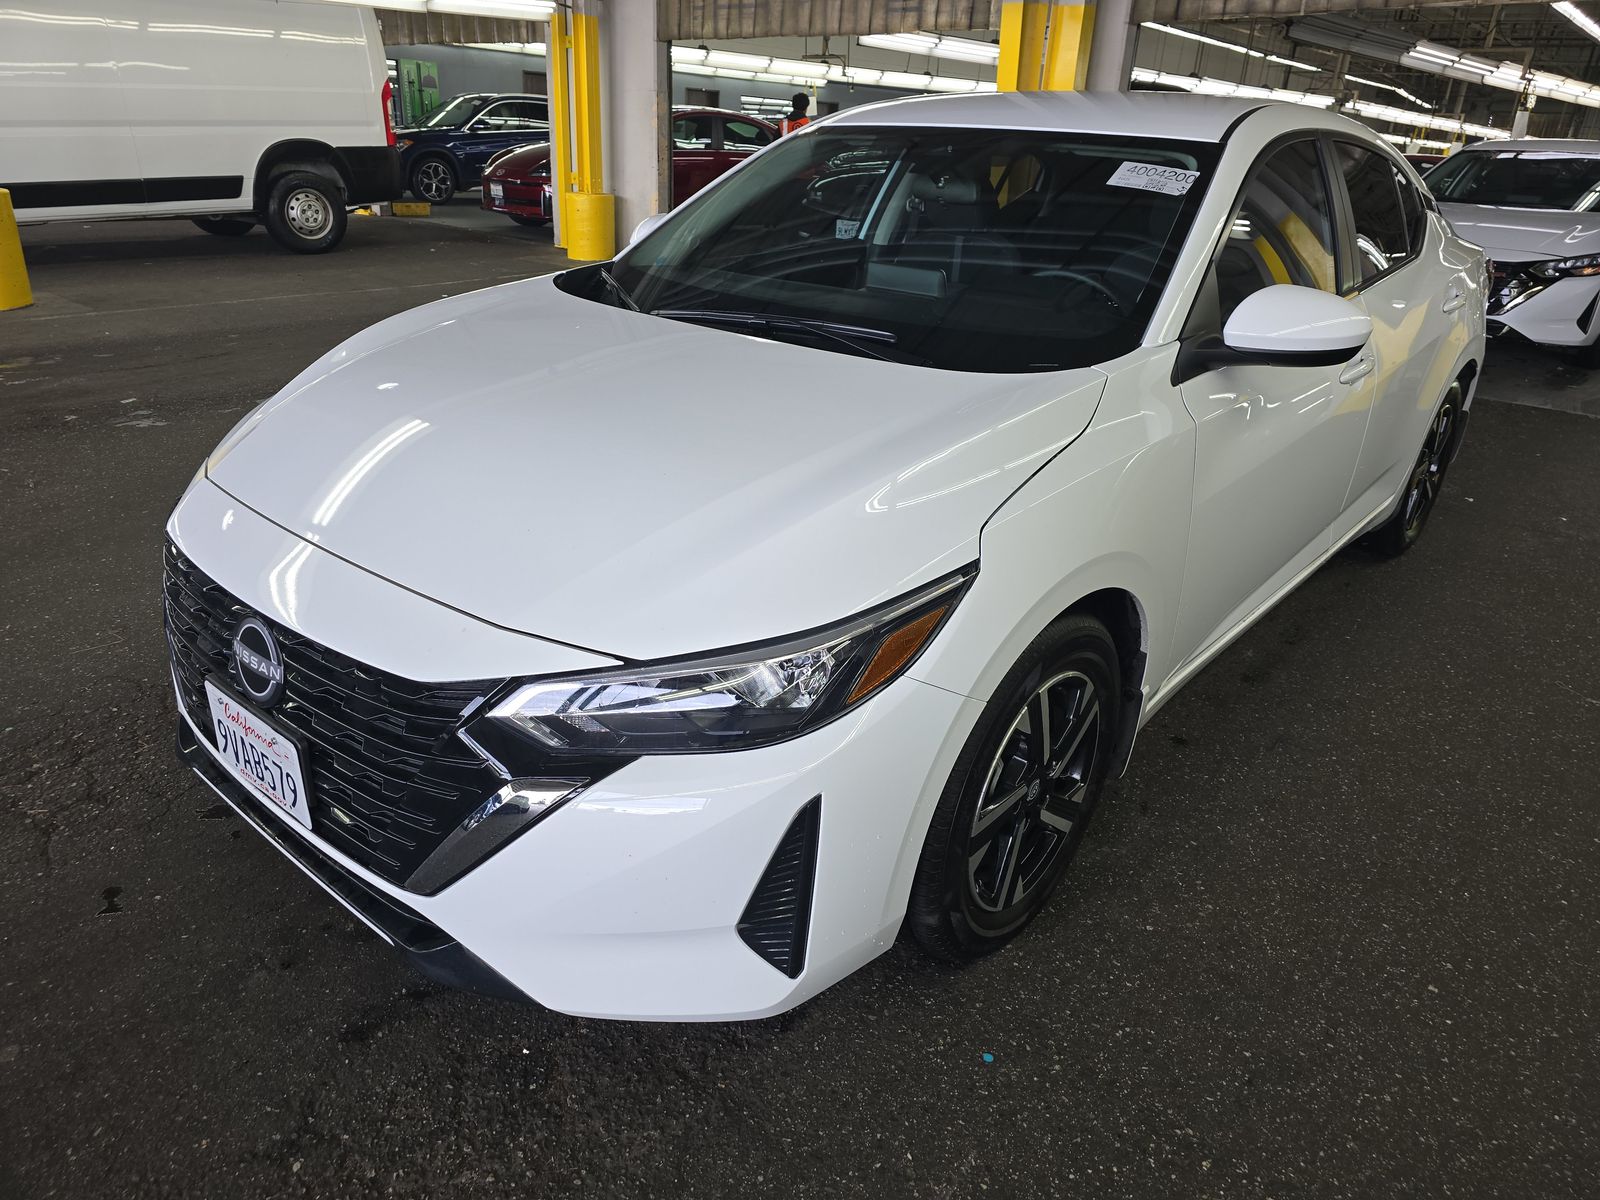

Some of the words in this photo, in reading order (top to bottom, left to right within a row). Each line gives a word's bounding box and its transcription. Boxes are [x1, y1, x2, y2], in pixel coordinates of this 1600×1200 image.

[1127, 165, 1197, 184] 4004200
[234, 638, 280, 680] NISSAN
[224, 702, 281, 757] California
[217, 718, 298, 808] 9VAB579
